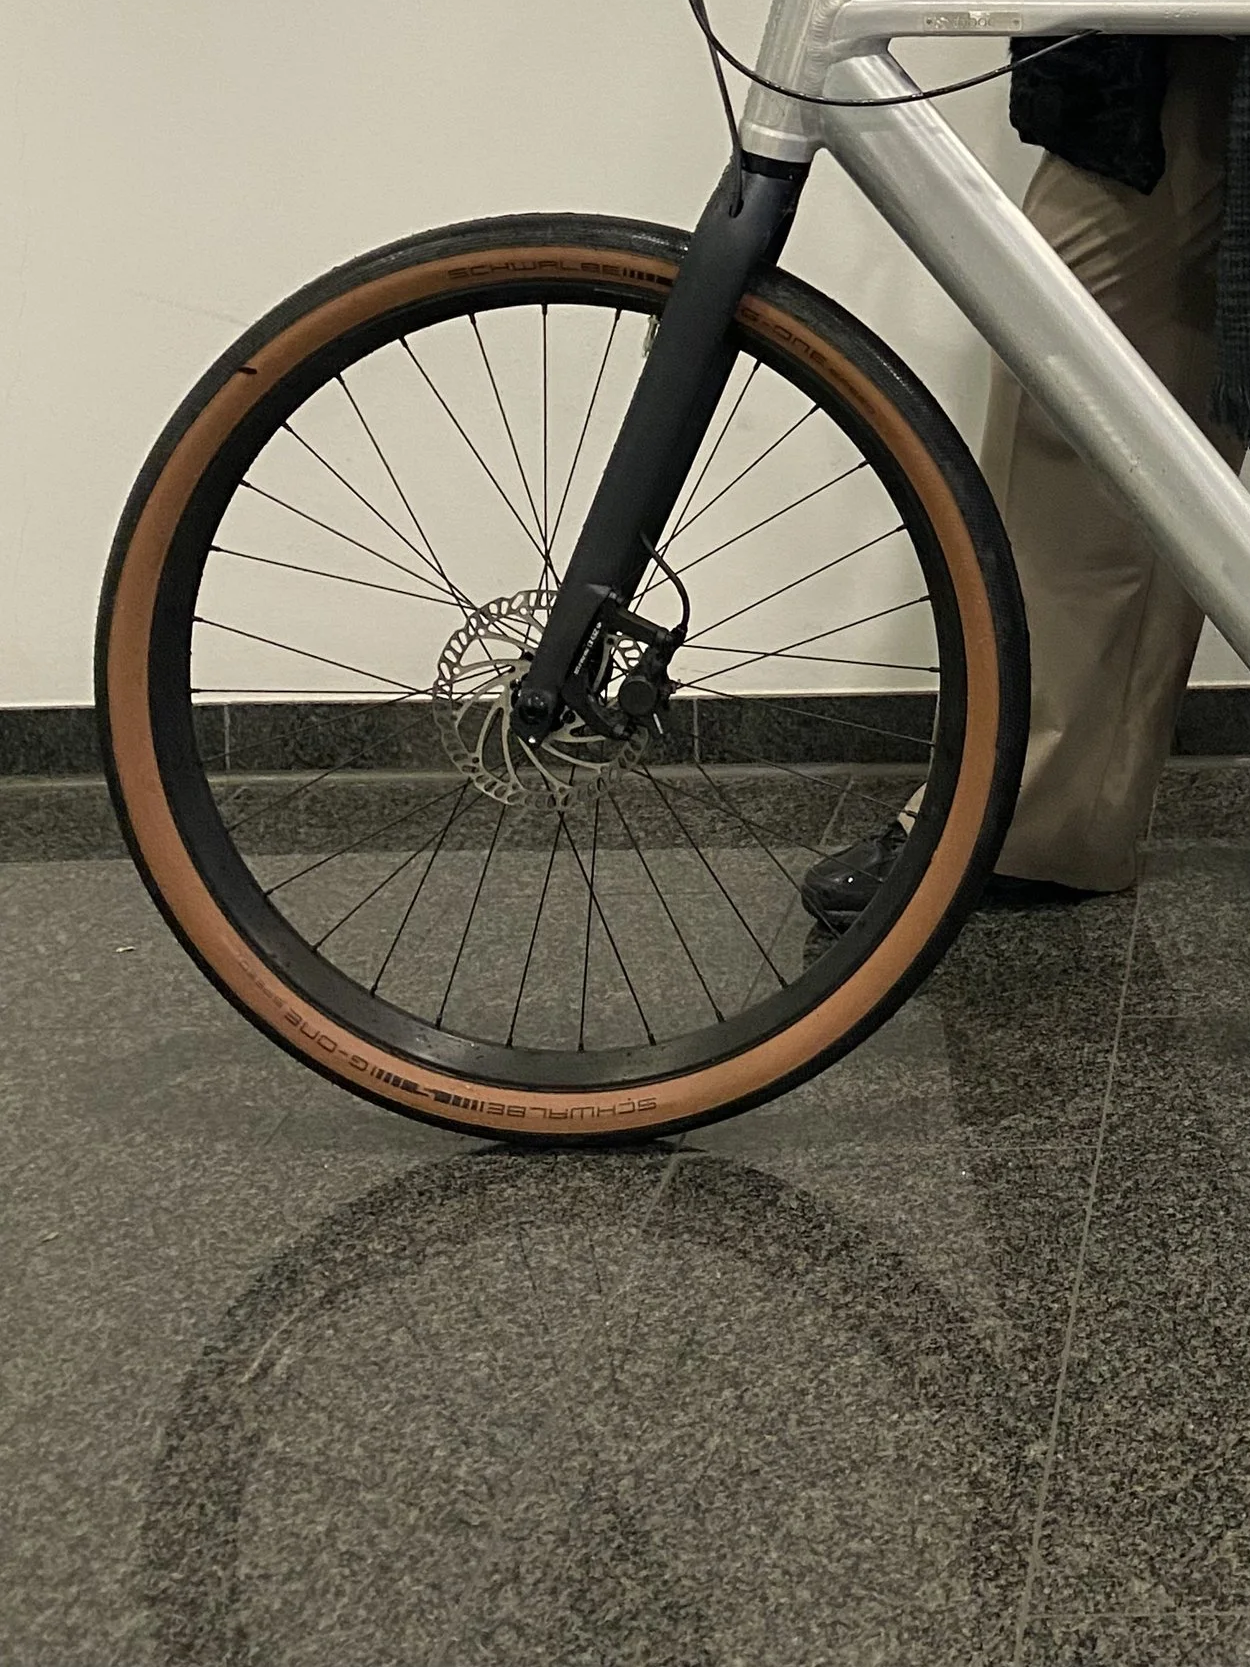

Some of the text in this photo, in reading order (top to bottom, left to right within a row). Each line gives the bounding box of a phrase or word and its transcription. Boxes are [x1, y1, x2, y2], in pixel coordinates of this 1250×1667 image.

[447, 260, 620, 280] SCHWALBE
[740, 308, 829, 366] G-ONE
[284, 1007, 370, 1072] G-ONE
[486, 1096, 657, 1121] SCHWALBE
